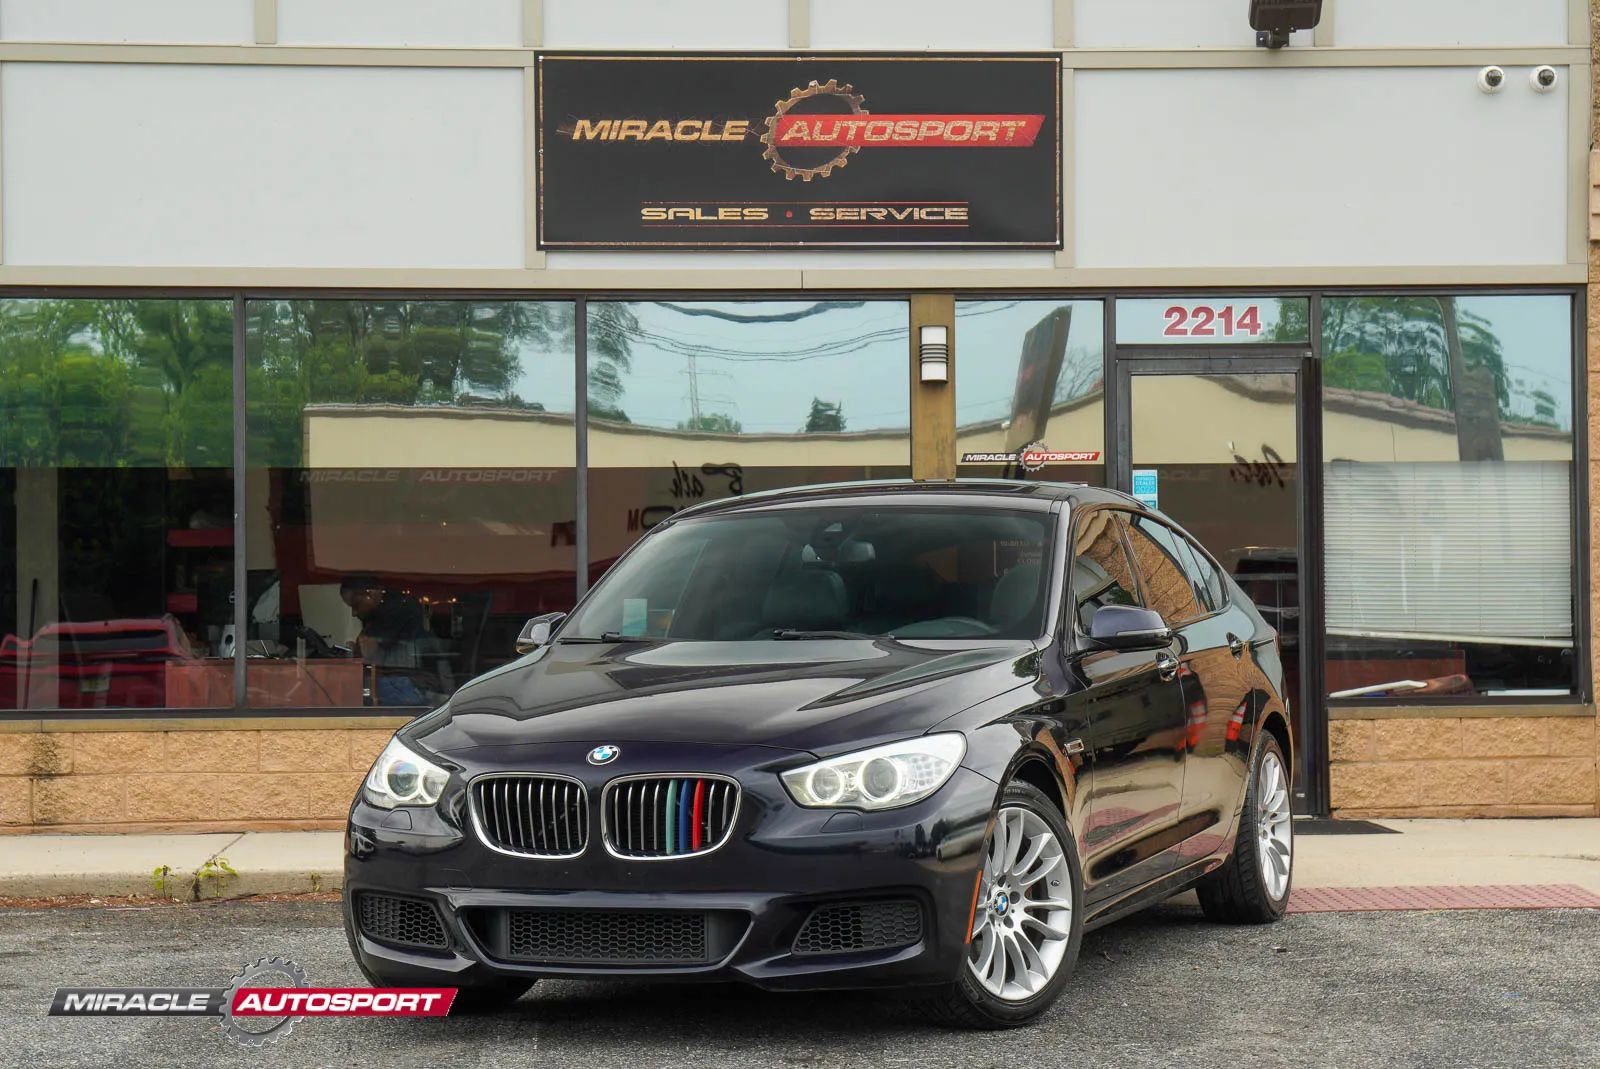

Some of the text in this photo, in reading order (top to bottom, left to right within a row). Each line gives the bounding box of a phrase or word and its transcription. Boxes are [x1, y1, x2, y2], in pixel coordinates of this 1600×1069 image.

[571, 119, 1027, 142] MIRACLE AUTOSPORT
[641, 206, 969, 221] SALES SERVICE
[1163, 304, 1262, 337] 2214
[965, 452, 1096, 461] MIRACLE AUTOSPORT
[418, 469, 559, 483] AUTOSPORT
